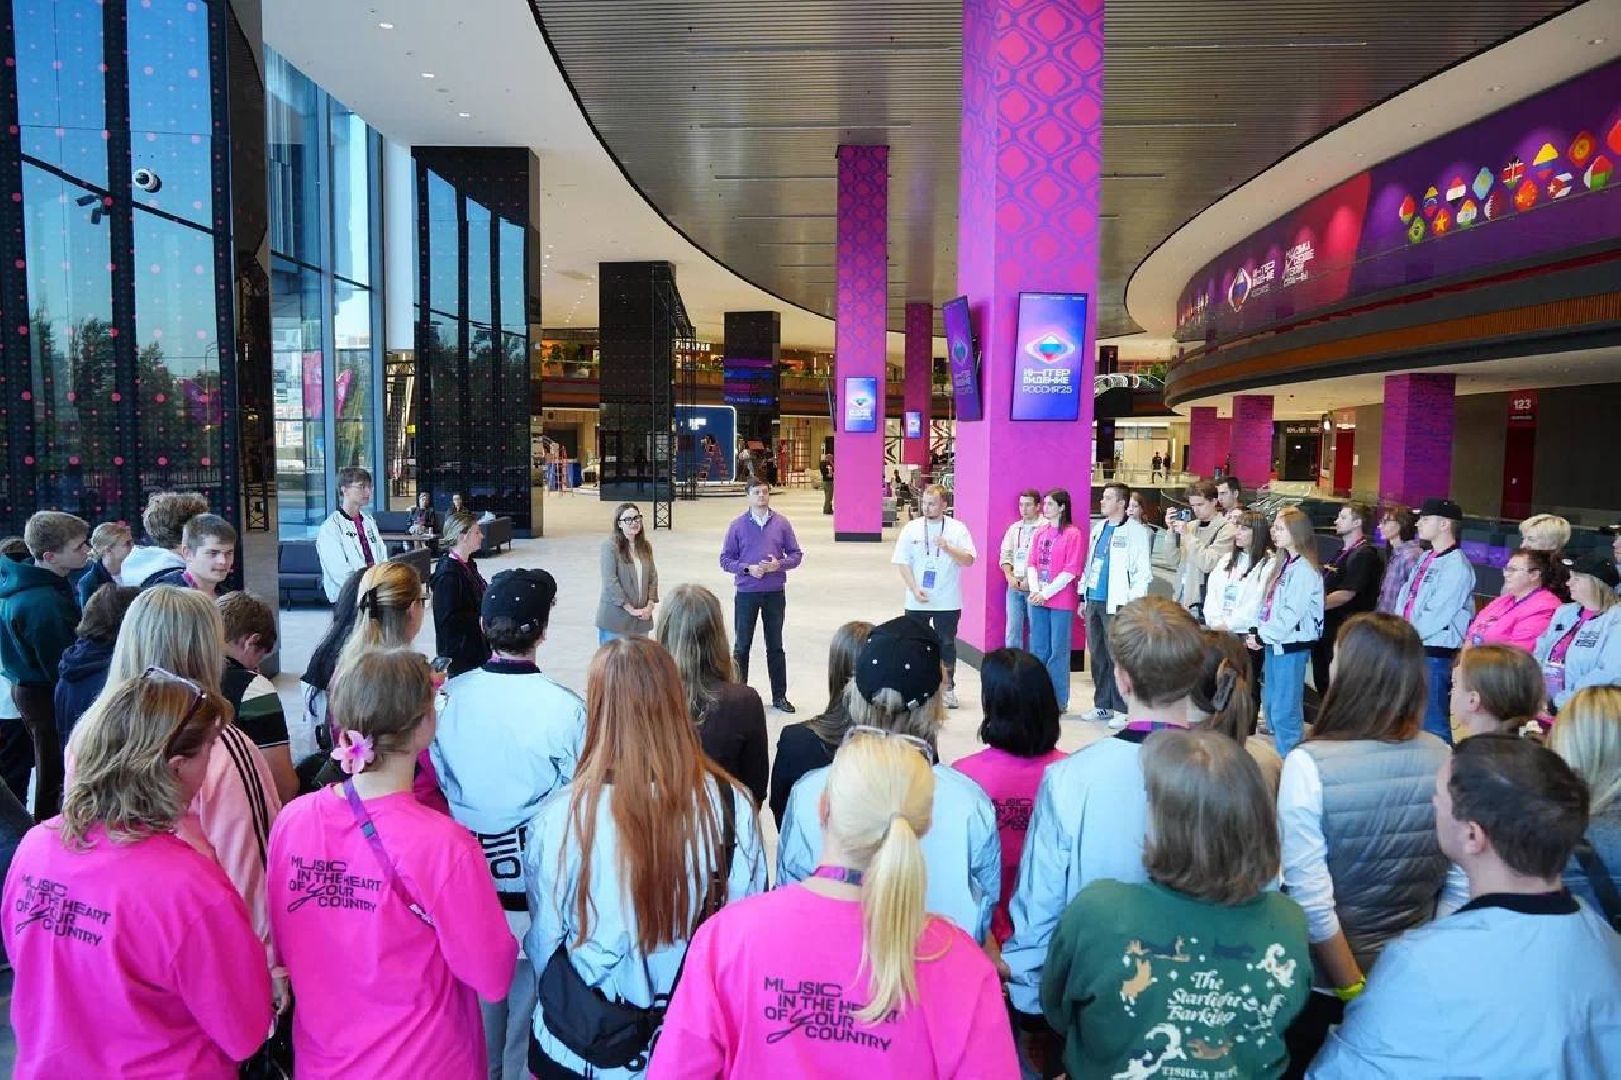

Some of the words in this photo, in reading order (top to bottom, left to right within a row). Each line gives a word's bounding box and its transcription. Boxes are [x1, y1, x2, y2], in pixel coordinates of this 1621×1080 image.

[1513, 399, 1532, 410] 123
[290, 856, 347, 873] MUSIC
[21, 874, 68, 898] MUSIC
[288, 878, 306, 892] OF
[296, 868, 312, 882] IN
[314, 871, 344, 884] THE
[343, 875, 382, 892] HEART
[15, 898, 31, 913] OF
[25, 889, 37, 902] IN
[39, 891, 60, 906] THE
[62, 898, 111, 925] HEART
[317, 895, 377, 913] COUNTRY
[42, 917, 103, 947] COUNTRY
[764, 977, 843, 997] MUSIC
[1190, 969, 1224, 991] The
[764, 1005, 789, 1021] OF
[777, 993, 797, 1009] IN
[799, 996, 836, 1013] THE
[805, 1025, 892, 1052] COUNTRY
